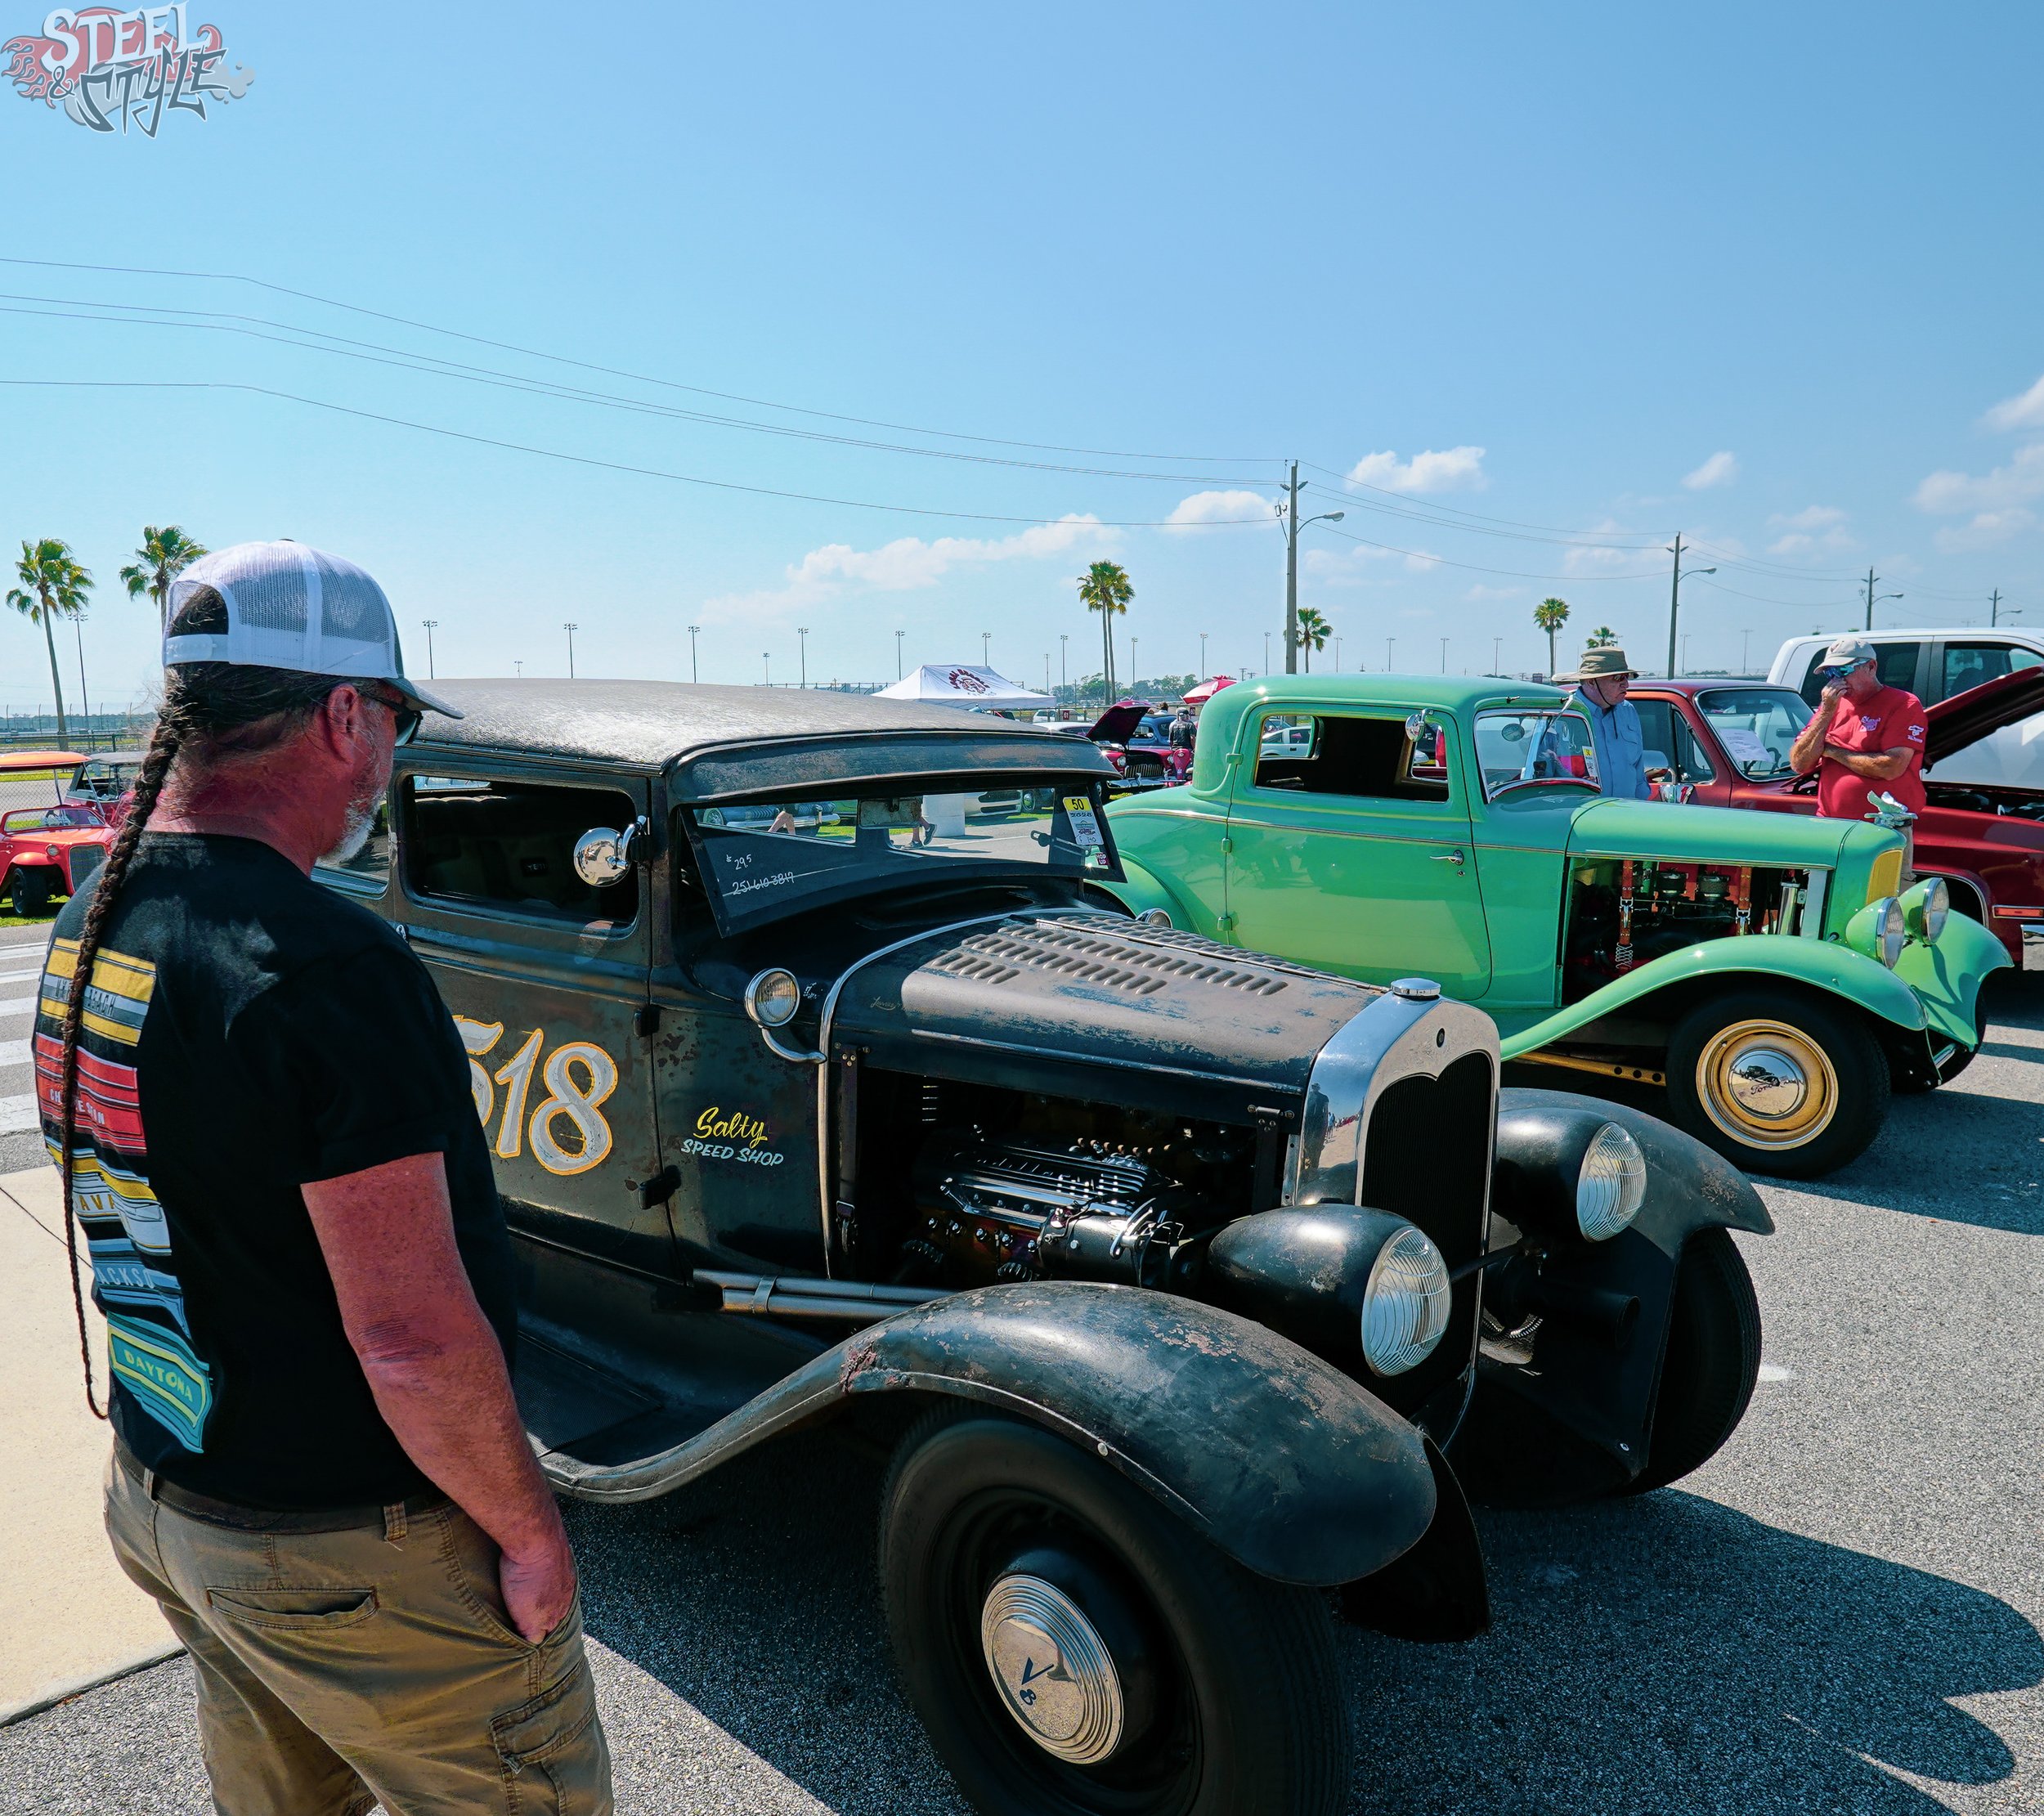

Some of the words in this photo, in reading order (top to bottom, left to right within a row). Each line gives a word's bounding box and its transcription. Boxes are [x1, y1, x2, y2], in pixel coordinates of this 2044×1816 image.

[1071, 798, 1085, 810] 50
[452, 1015, 619, 1176] 518
[693, 1106, 768, 1149] Salty
[681, 1138, 735, 1160] SPEED
[736, 1147, 785, 1167] SHOP
[95, 1267, 155, 1289] ACKSO
[123, 1350, 193, 1402] DAYTONA
